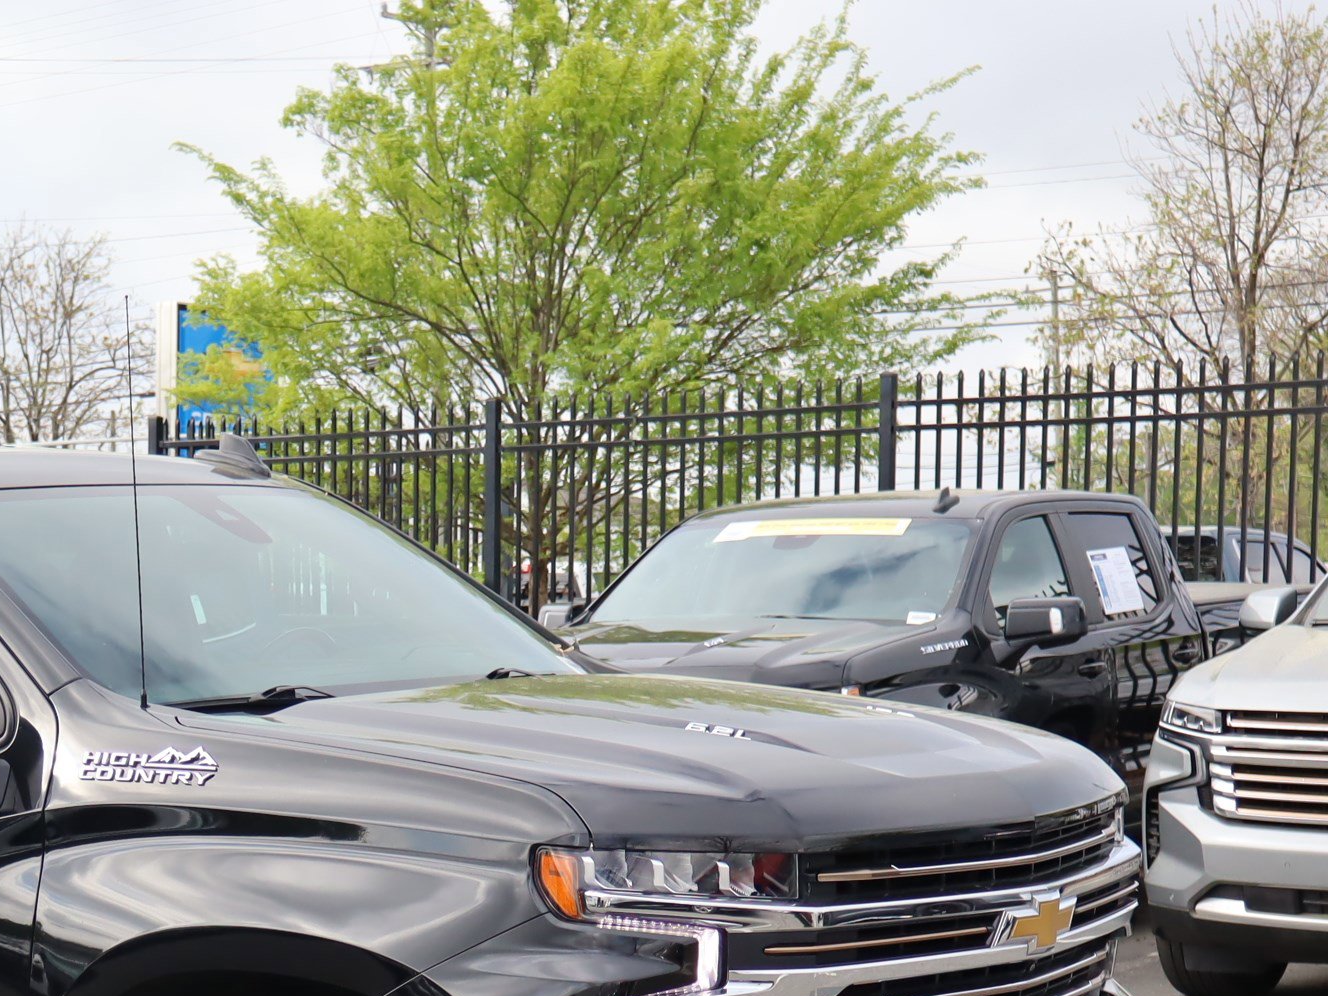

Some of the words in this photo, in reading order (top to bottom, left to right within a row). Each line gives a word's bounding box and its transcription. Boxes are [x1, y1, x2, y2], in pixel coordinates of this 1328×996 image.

[684, 721, 752, 741] 6.2L
[82, 750, 150, 767] HIGH
[78, 765, 216, 787] COUNTRY
